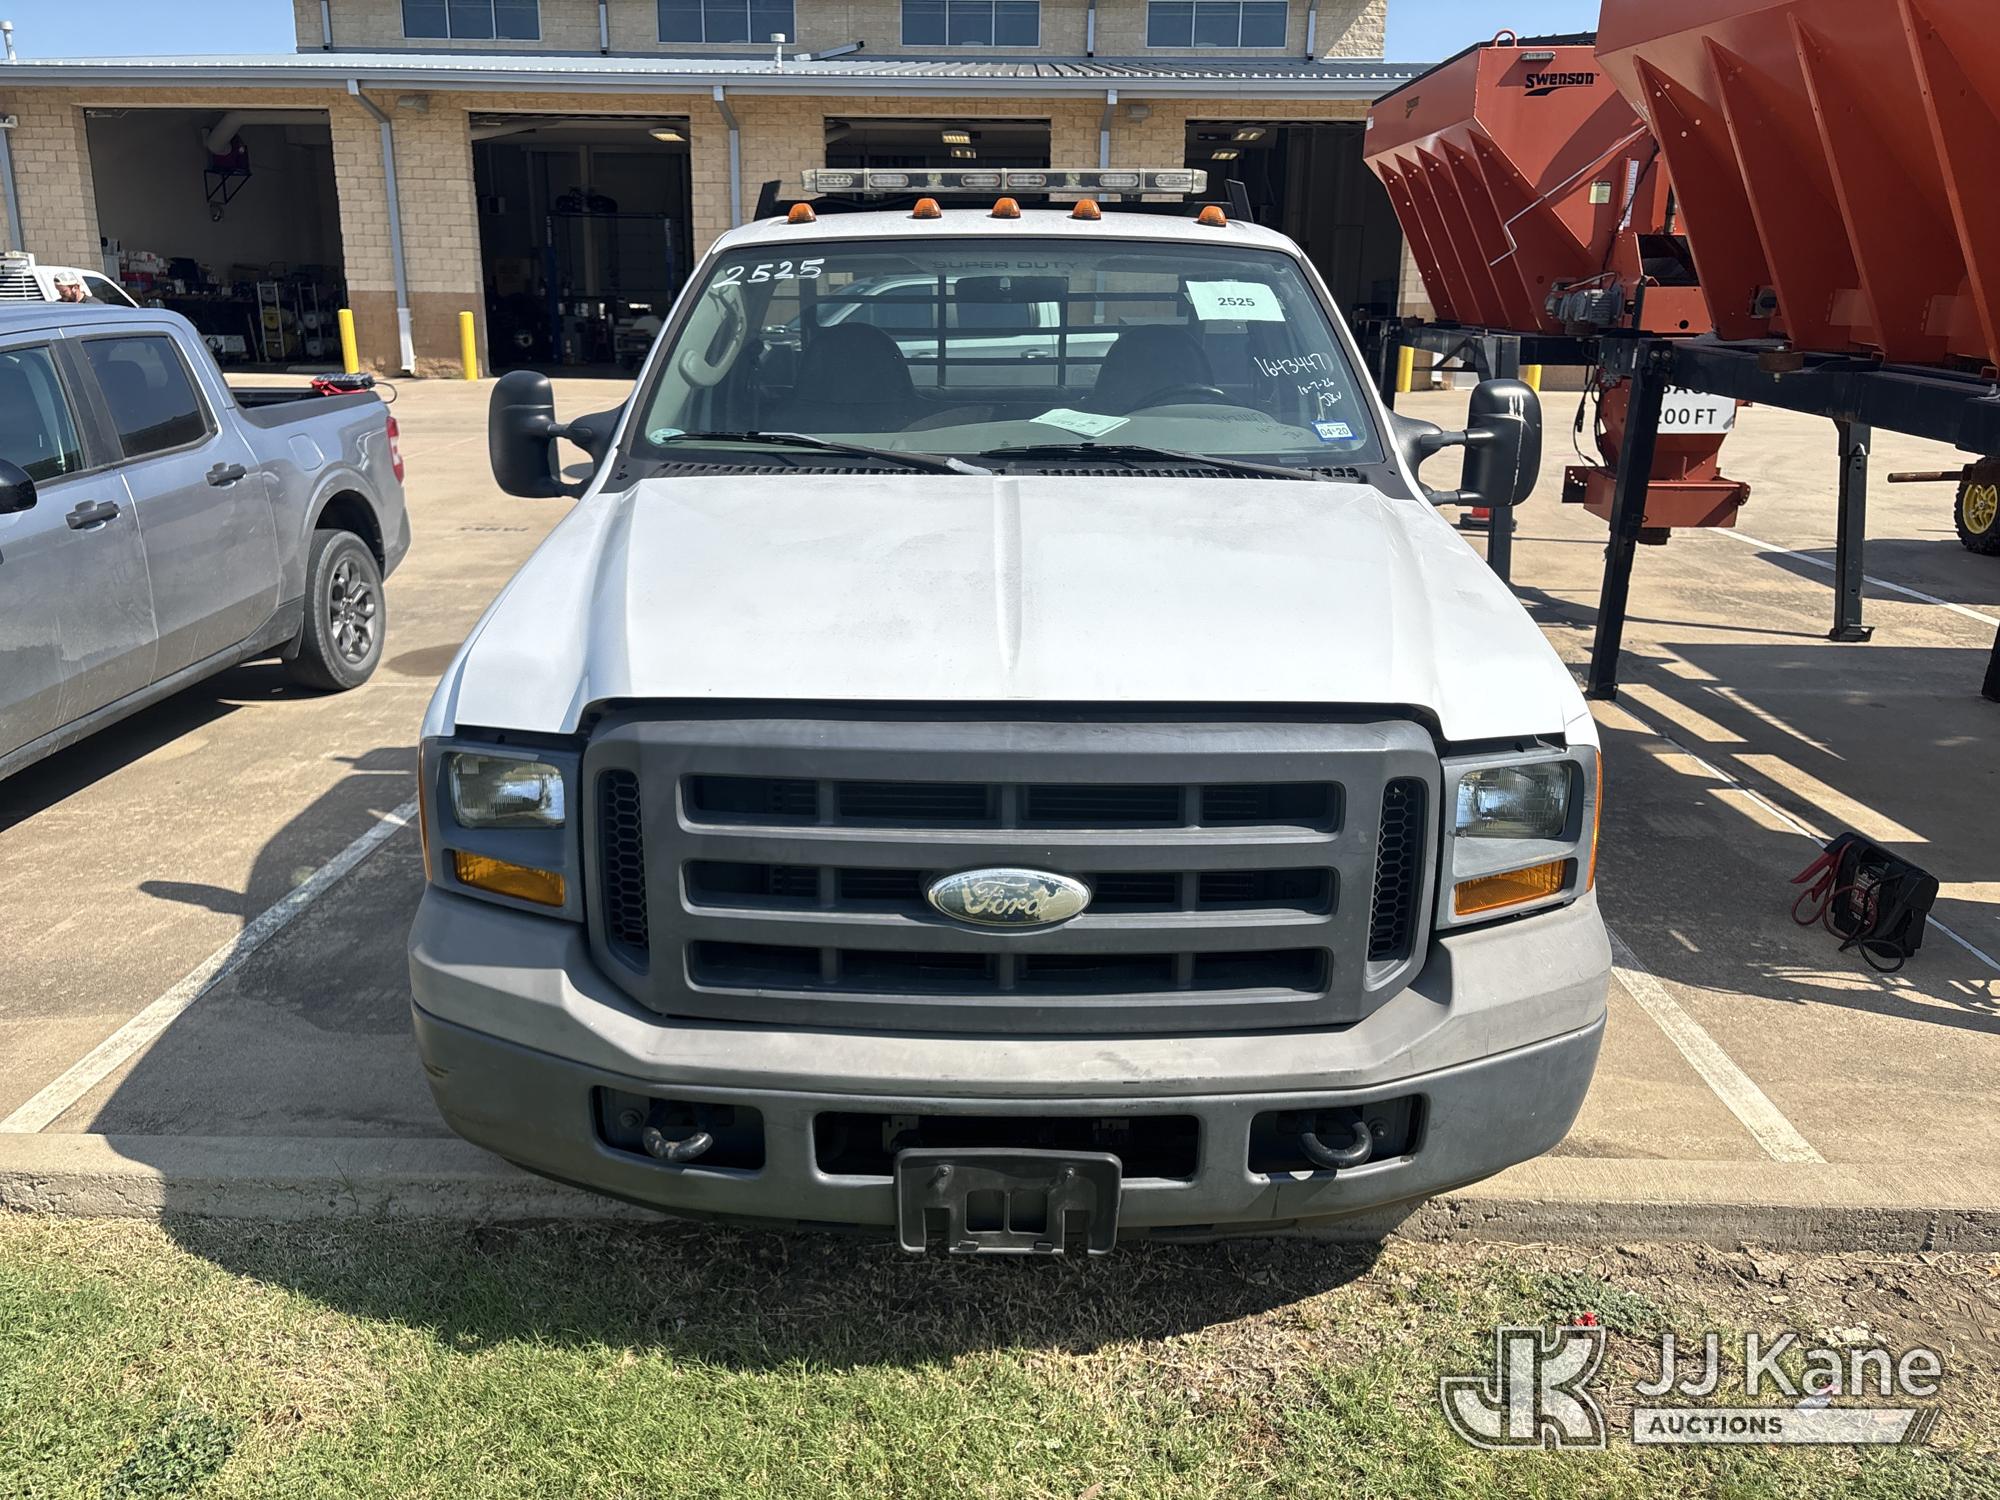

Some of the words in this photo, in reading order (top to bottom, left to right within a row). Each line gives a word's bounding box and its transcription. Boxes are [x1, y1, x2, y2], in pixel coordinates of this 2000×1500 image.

[712, 258, 825, 289] 2525
[933, 261, 1009, 269] SUPER
[1016, 261, 1079, 269] DUTY
[1217, 297, 1256, 307] 2525
[1253, 353, 1327, 377] 1643447
[1658, 408, 1691, 425] 00
[1694, 408, 1717, 425] FT
[962, 880, 1047, 915] Ford
